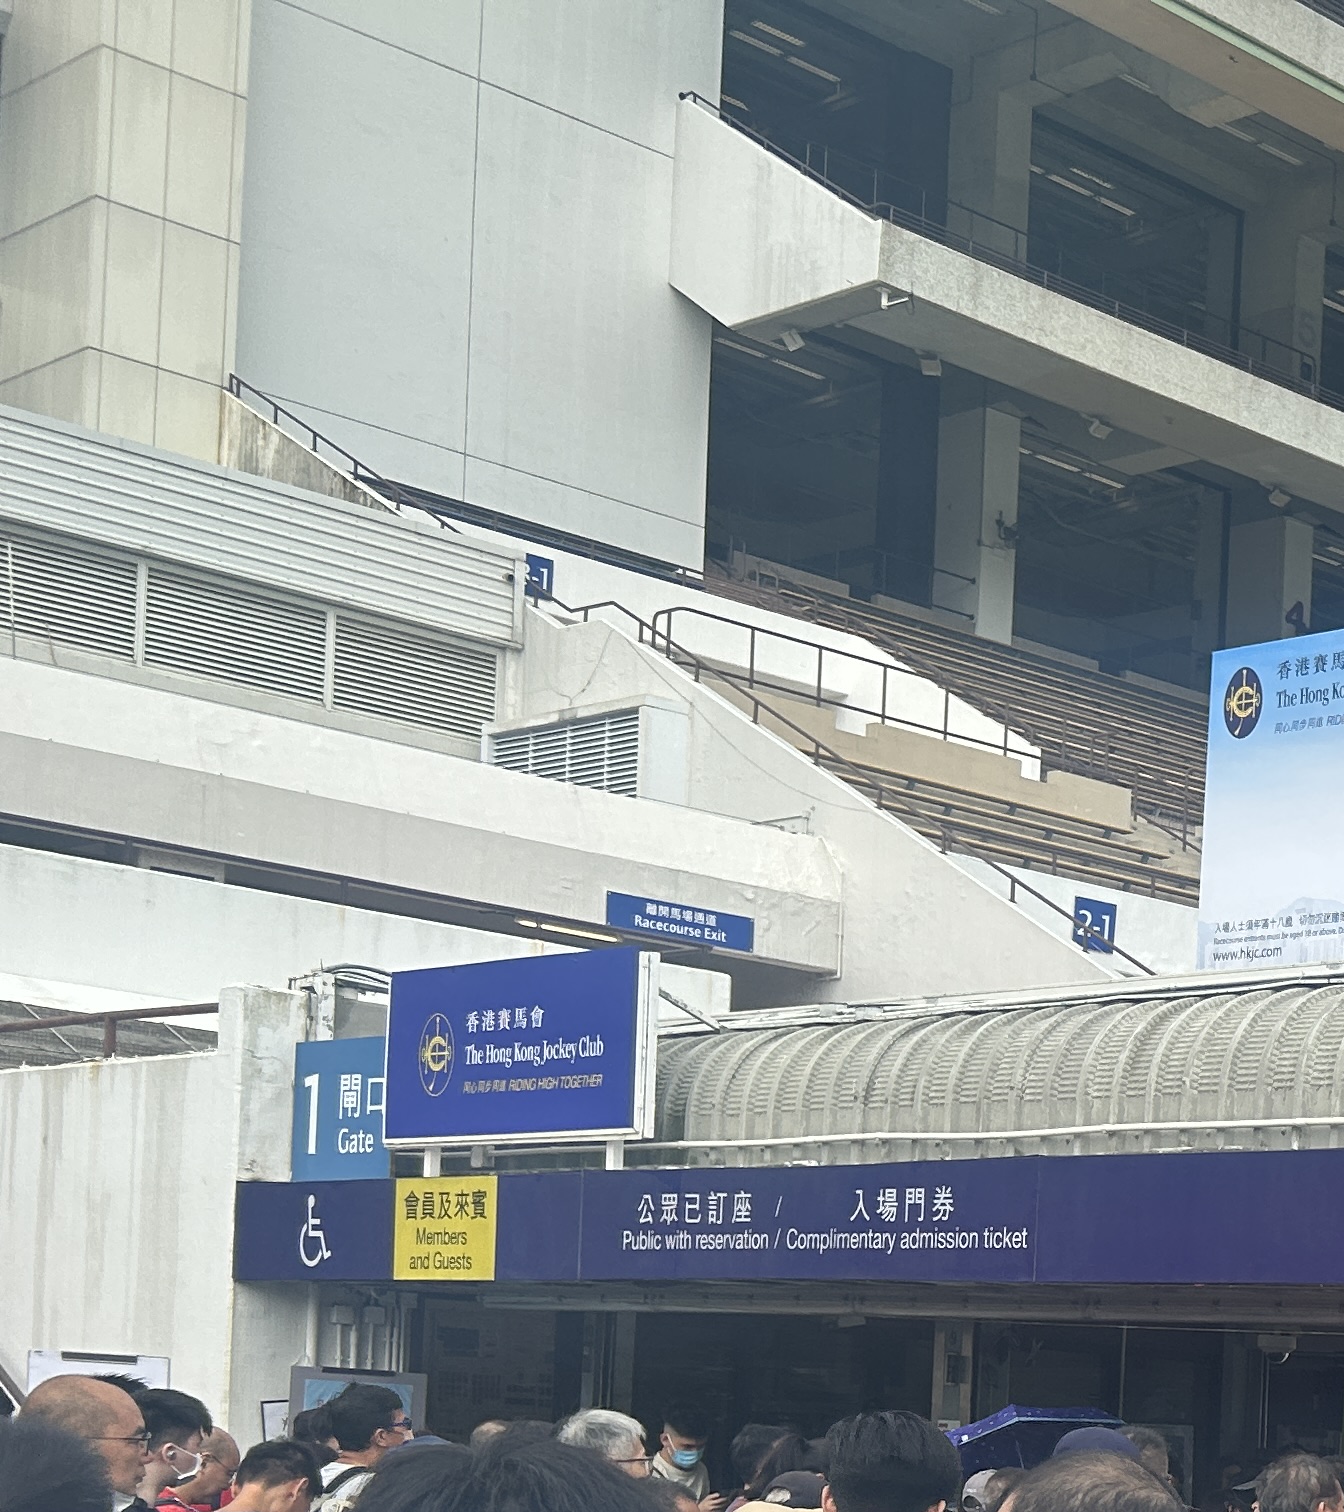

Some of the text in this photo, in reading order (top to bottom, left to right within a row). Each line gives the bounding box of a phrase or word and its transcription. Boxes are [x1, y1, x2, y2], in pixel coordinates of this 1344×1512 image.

[1276, 689, 1297, 708] The
[1299, 687, 1329, 706] Hong
[634, 914, 727, 943] Racecourse Exit
[645, 902, 717, 927] 離開馬場通道
[1077, 909, 1110, 940] 2-1
[1290, 930, 1303, 941] aged
[1213, 946, 1282, 962] www.hkjc.com
[465, 1005, 545, 1035] 香港賽馬會
[464, 1034, 604, 1069] The Hong Kong Jockey Club
[508, 1077, 537, 1092] RIDING
[537, 1076, 559, 1090] HIGH
[560, 1073, 604, 1089] TOGETHER
[303, 1073, 320, 1155] 1
[337, 1129, 375, 1157] Gate
[404, 1189, 488, 1221] 會員及來賓
[637, 1186, 956, 1226] 公眾已訂座 / 入場門券
[415, 1227, 468, 1246] Members
[622, 1225, 1028, 1256] Public with reservation / Complimentary admission ticket
[409, 1251, 473, 1270] and Guests
